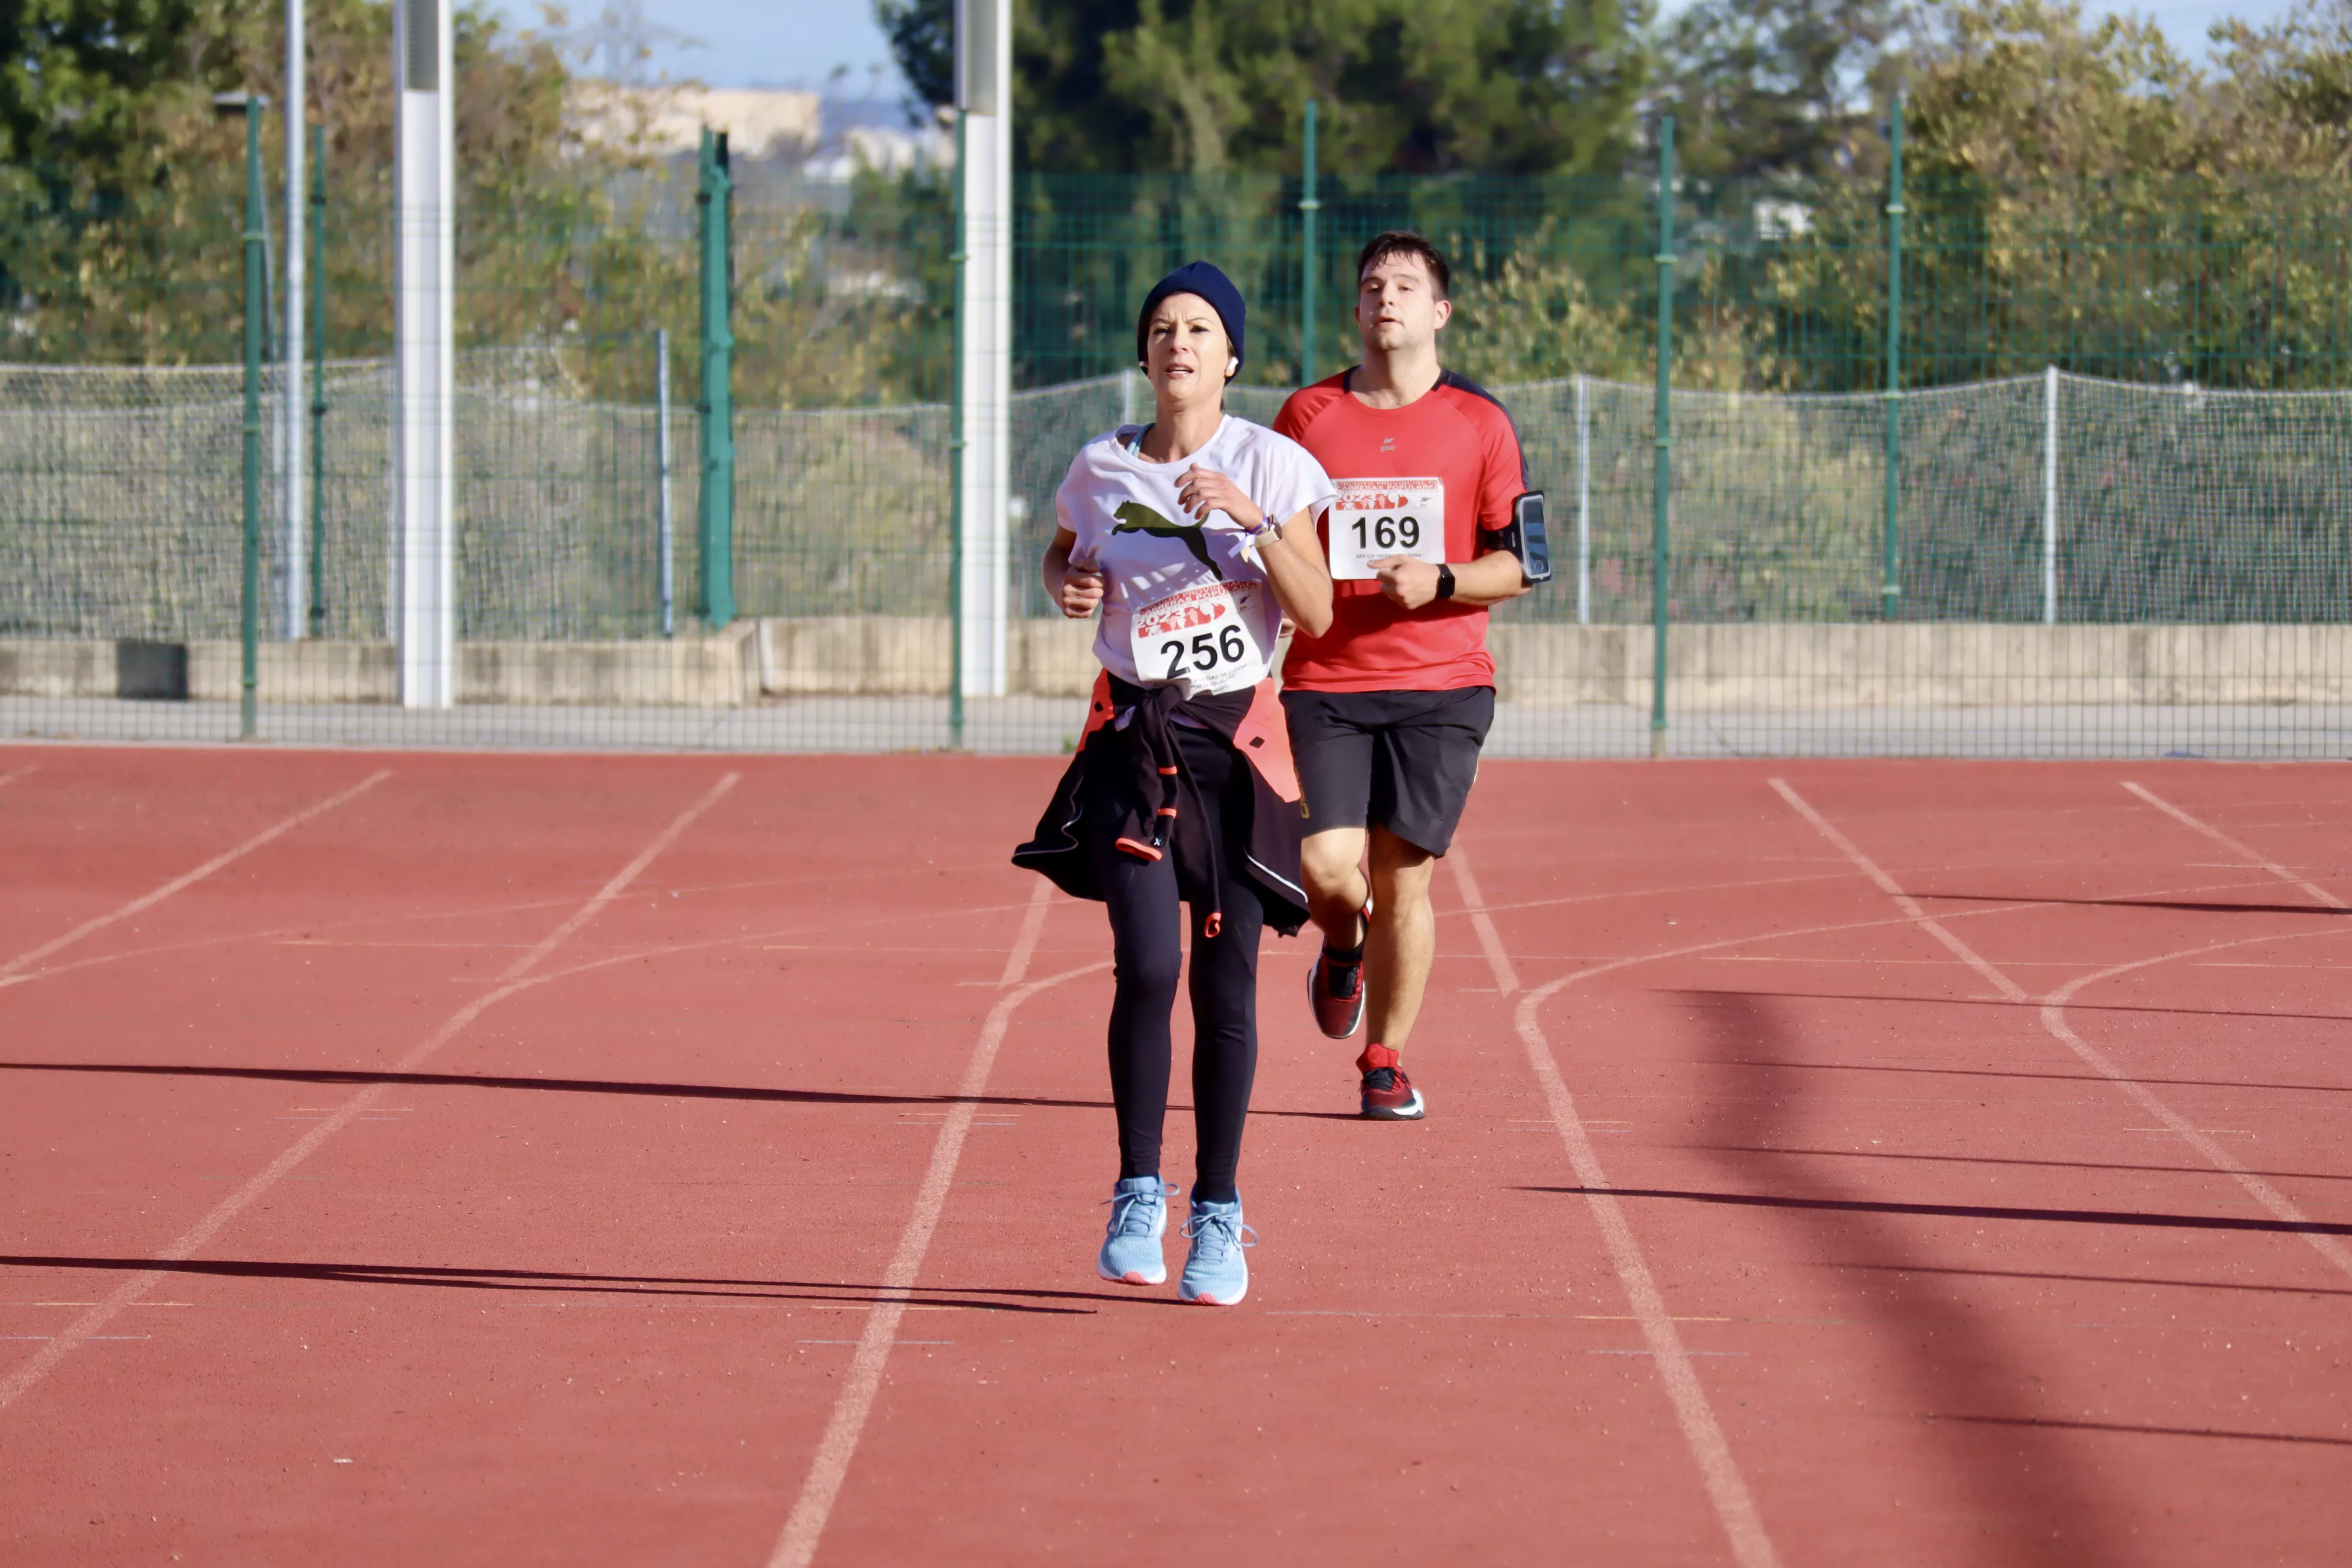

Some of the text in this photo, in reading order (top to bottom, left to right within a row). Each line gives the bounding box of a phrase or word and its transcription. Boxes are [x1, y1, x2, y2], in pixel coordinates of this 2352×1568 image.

[1336, 493, 1376, 502] 2023
[1351, 516, 1420, 549] 169
[1138, 609, 1186, 627] 2023
[1161, 624, 1244, 680] 256
